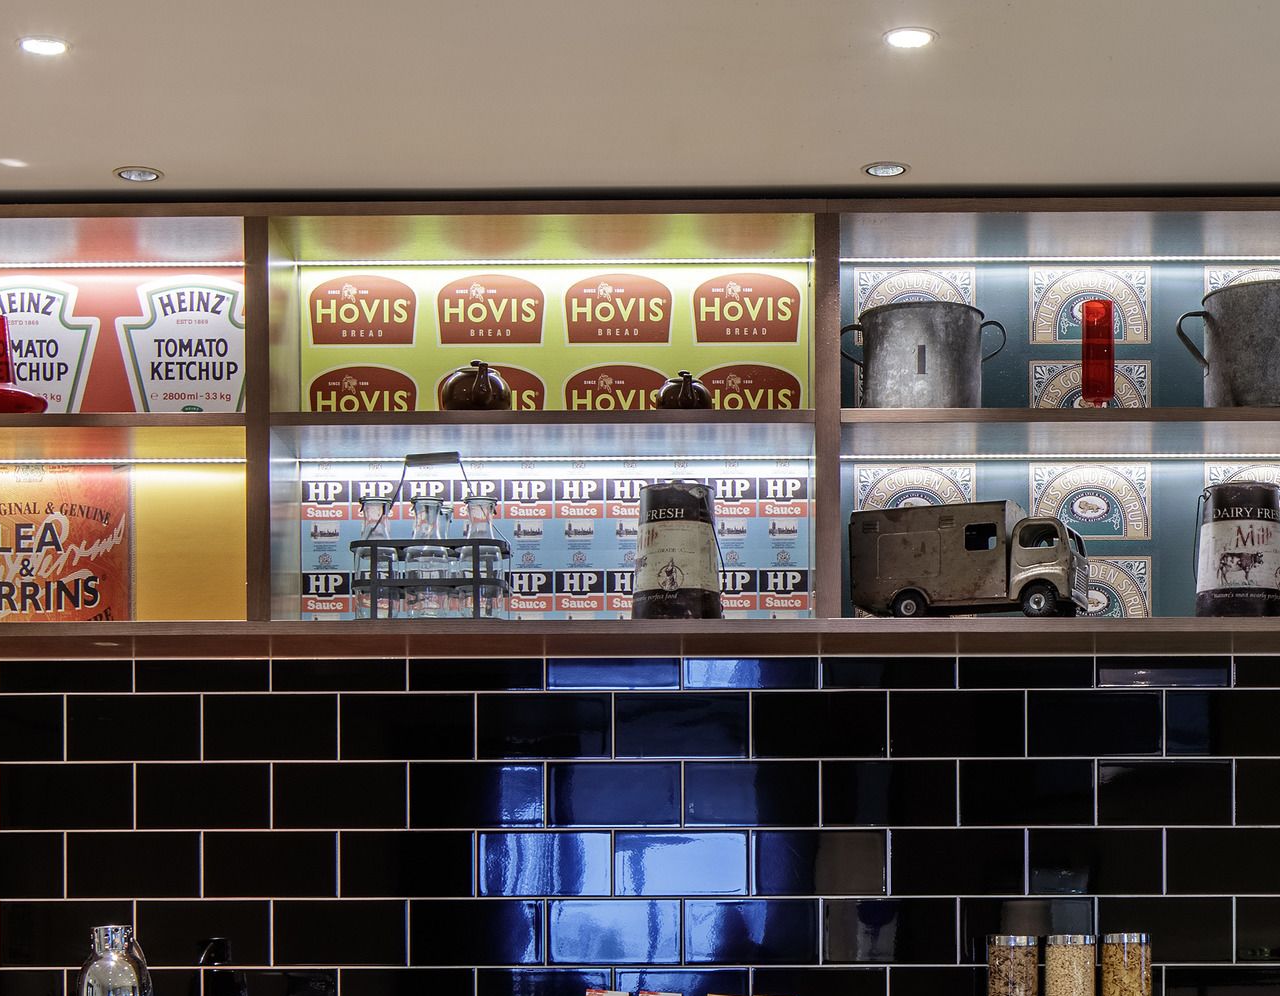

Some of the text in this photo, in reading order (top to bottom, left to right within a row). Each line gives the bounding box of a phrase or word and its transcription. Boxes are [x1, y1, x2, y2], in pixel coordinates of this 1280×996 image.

[1060, 272, 1119, 296] GOLDEN
[1118, 294, 1143, 335] SYRUP
[341, 329, 384, 338] BREAD
[470, 329, 511, 338] BREAD
[726, 327, 767, 336] BREAD
[154, 338, 228, 358] TOMATO
[150, 362, 238, 381] KETCHUP
[766, 479, 800, 498] HP
[885, 468, 943, 492] GOLDEN
[308, 482, 343, 500] HP
[512, 481, 546, 500] HP
[1060, 468, 1143, 531] GOLDEN SYRUP
[45, 501, 55, 515] &
[60, 503, 111, 527] GENUINE
[307, 508, 343, 518] Sauce
[510, 507, 546, 517] Sauce
[647, 508, 684, 519] FRESH
[765, 505, 800, 515] Sauce
[1214, 508, 1252, 518] DAIRY
[20, 559, 35, 578] &
